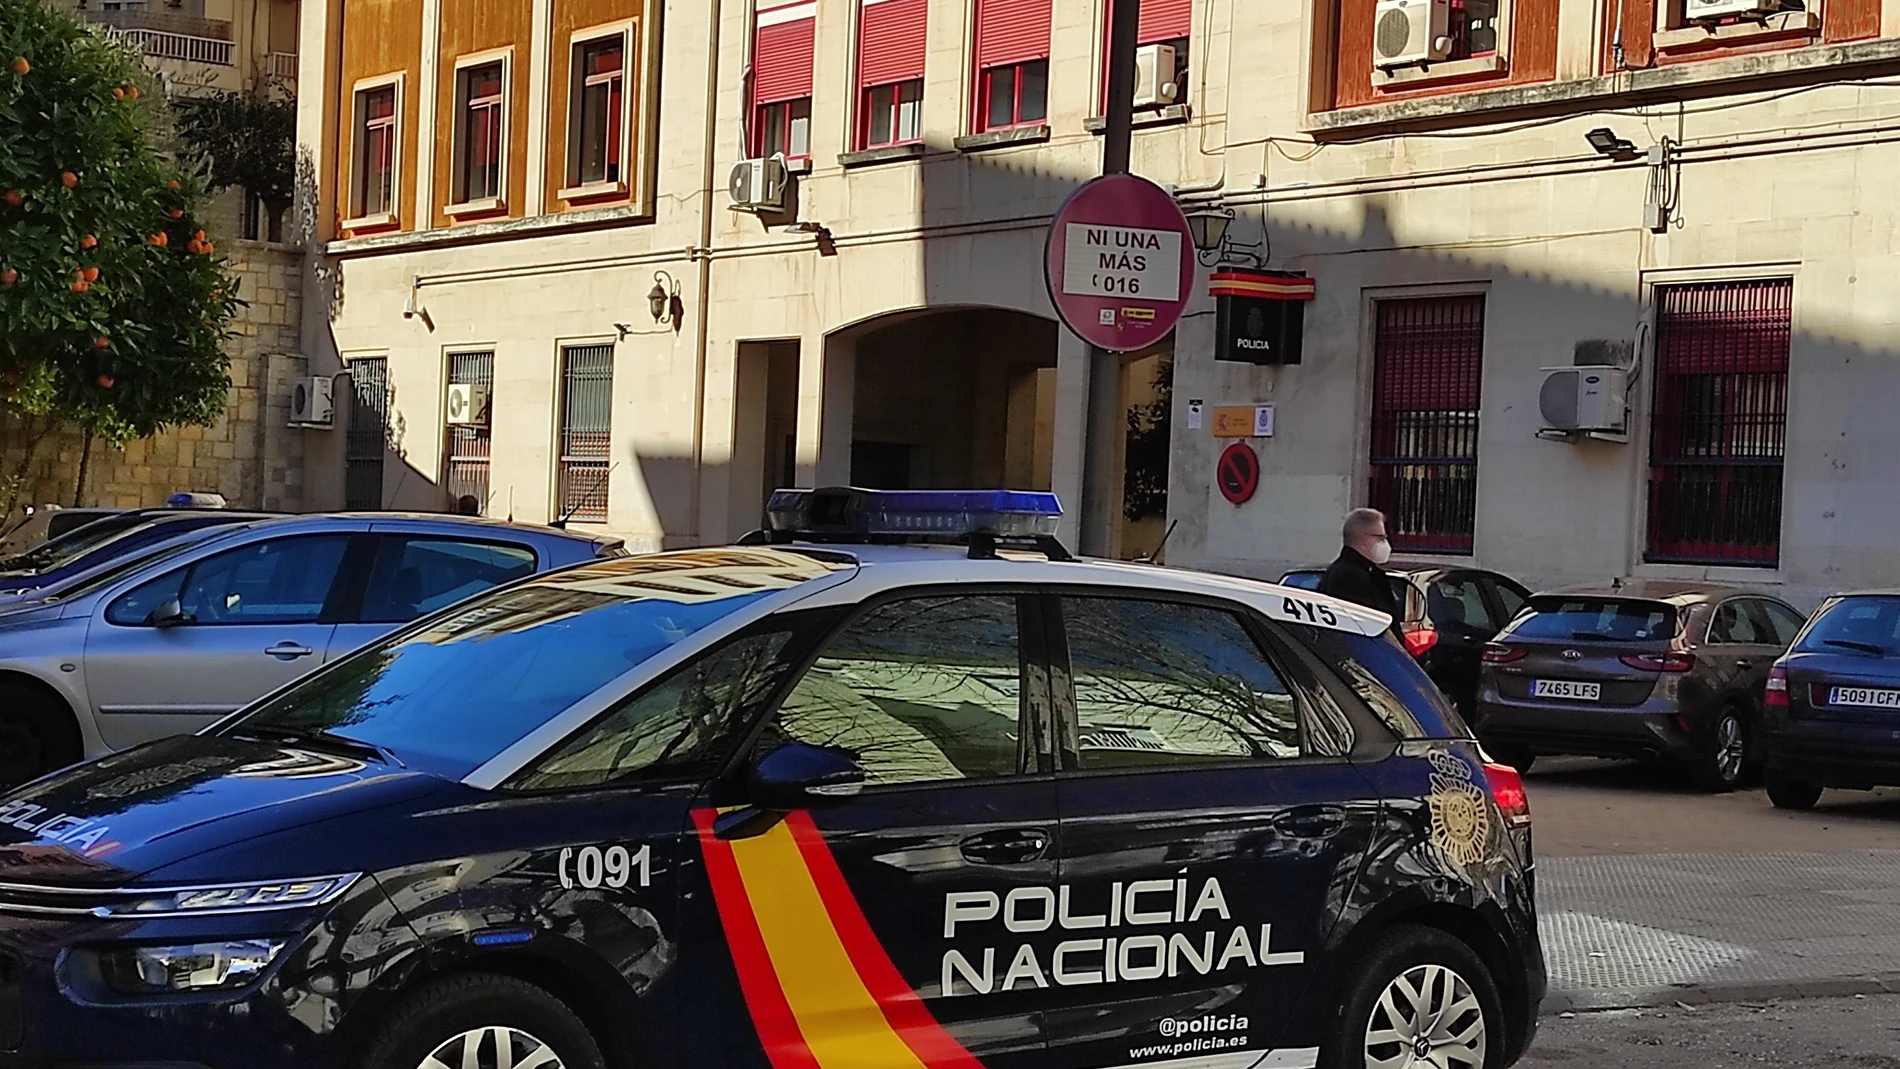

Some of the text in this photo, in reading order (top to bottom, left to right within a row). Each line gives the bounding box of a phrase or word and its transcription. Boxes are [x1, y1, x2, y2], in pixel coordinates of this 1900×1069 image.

[1087, 229, 1161, 250] NI UNA
[1099, 251, 1146, 271] MÁS
[1104, 276, 1140, 293] 016
[1237, 338, 1270, 350] POLICIA
[1283, 597, 1337, 626] 4Y5
[1539, 682, 1598, 697] 7465 LFS
[1841, 690, 1874, 704] 5091
[577, 845, 650, 888] 091
[944, 867, 1231, 938] POLICÍA
[942, 923, 1304, 997] NACIONAL
[1159, 1014, 1249, 1037] @policia
[1129, 1036, 1248, 1058] www.policia.es
